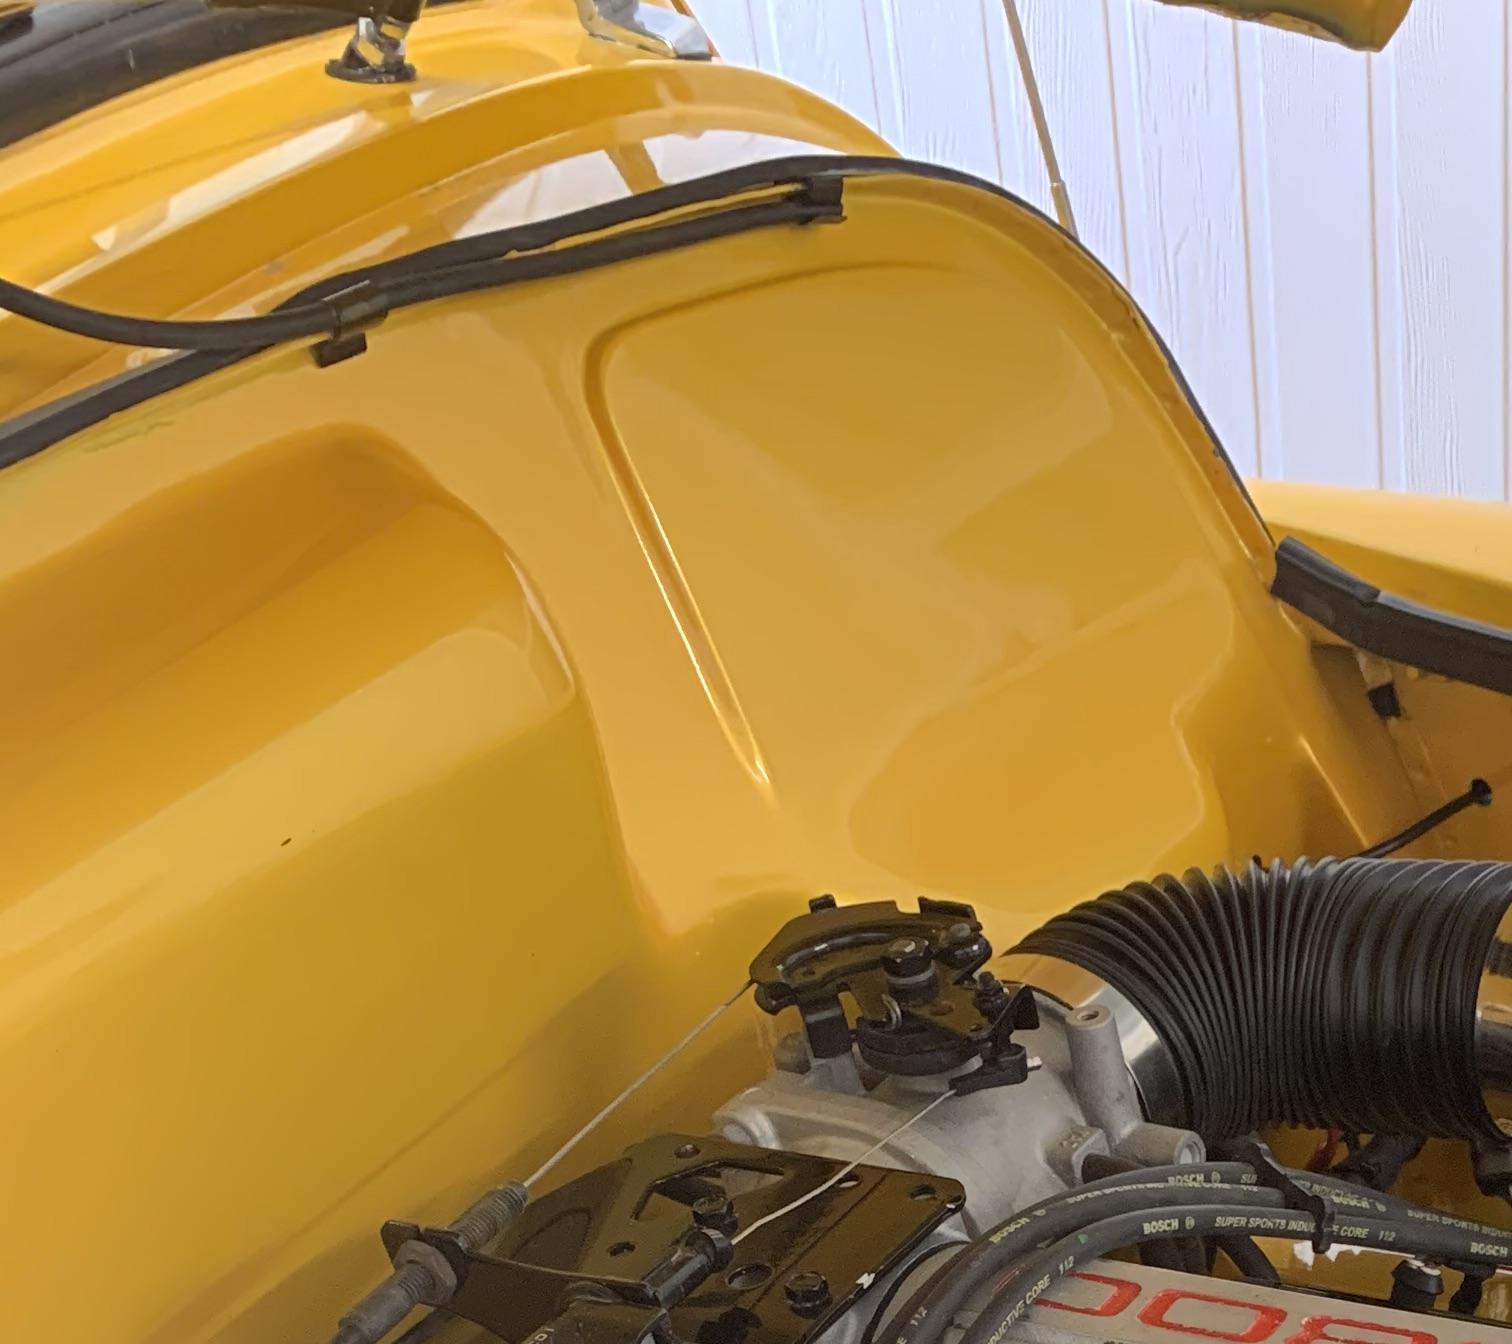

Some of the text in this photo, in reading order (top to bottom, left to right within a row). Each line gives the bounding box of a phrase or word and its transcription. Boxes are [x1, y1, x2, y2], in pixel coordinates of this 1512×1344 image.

[1408, 1209, 1440, 1223] SUPER
[989, 1217, 1030, 1244] BOSCH
[1142, 1217, 1179, 1235] BOSCH
[1214, 1215, 1247, 1229] SUPER
[1248, 1216, 1286, 1230] SPORTS
[1341, 1227, 1371, 1239] CORE
[1378, 1230, 1396, 1242] 112
[1470, 1242, 1509, 1258] BOSCH
[1025, 1272, 1051, 1304] CORE
[1058, 1255, 1075, 1275] 112
[909, 1306, 928, 1326] 112
